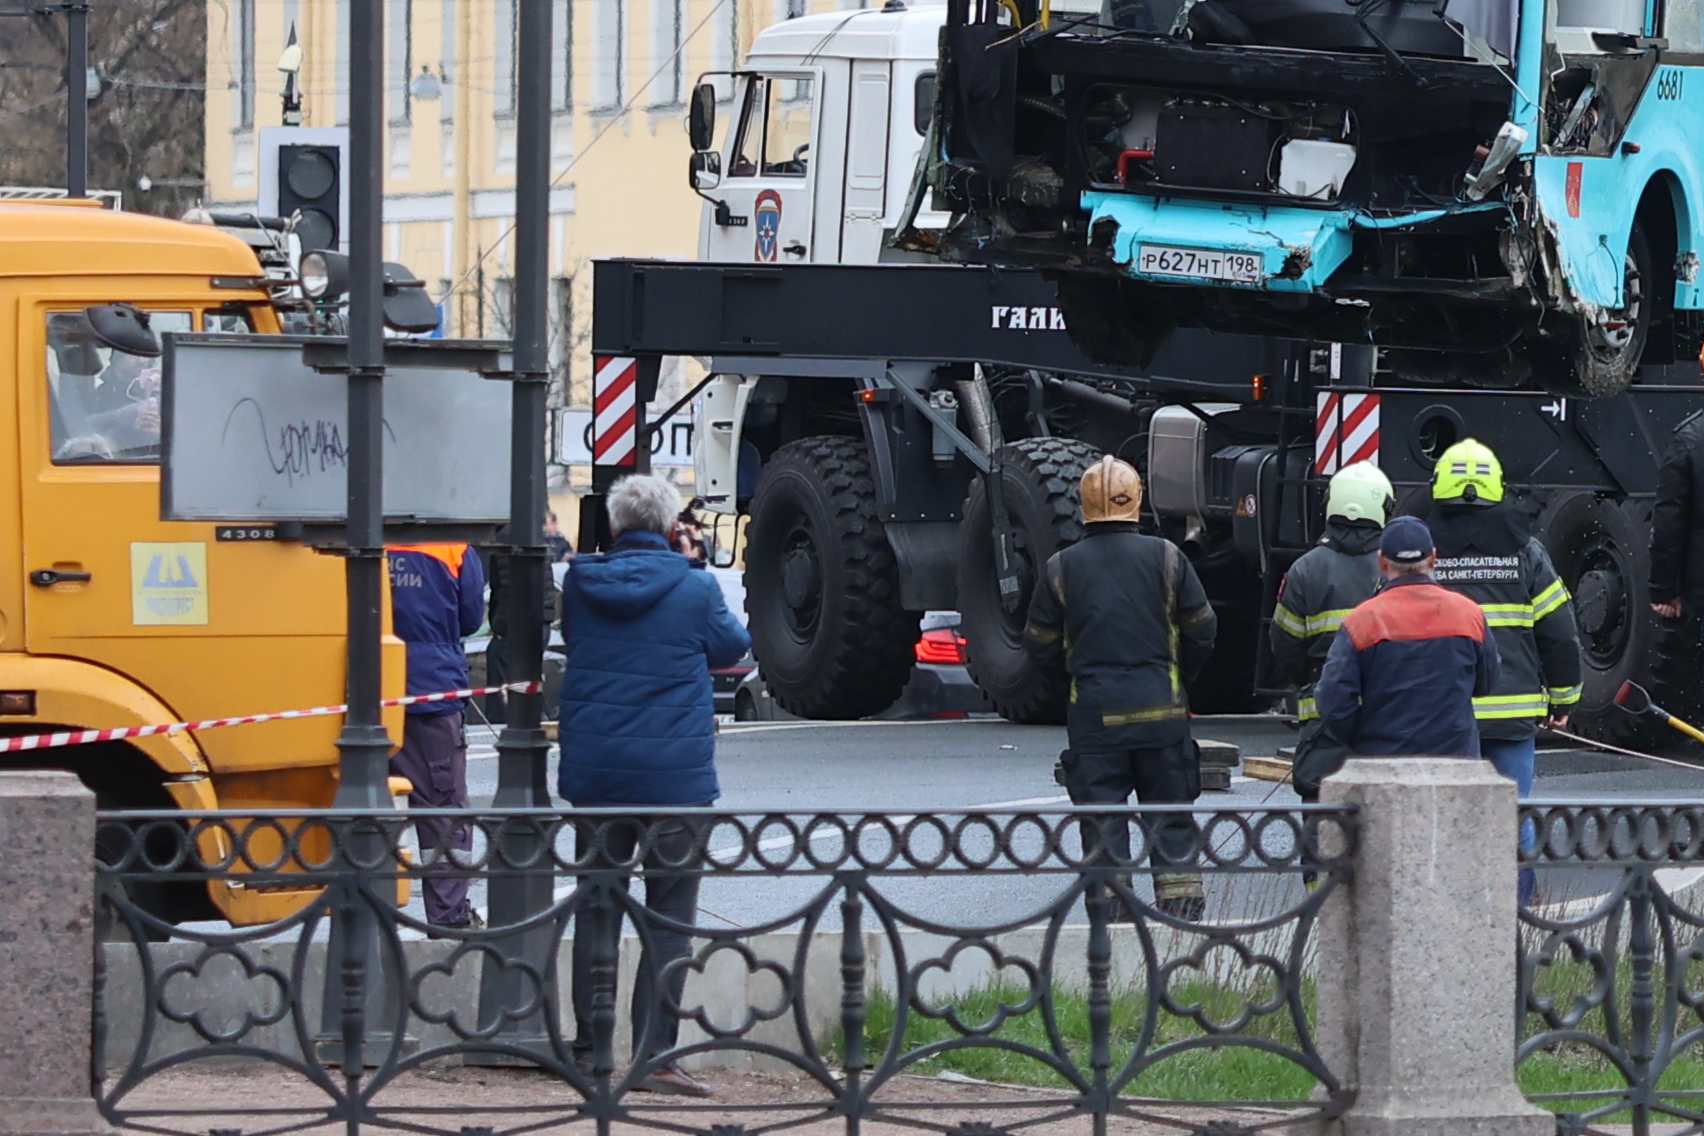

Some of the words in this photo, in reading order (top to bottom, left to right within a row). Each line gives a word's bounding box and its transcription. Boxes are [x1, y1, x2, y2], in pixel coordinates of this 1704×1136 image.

[1657, 70, 1683, 100] 6681
[1225, 256, 1254, 273] 198
[222, 529, 275, 539] 4308
[1448, 568, 1519, 580] САНКТ-ПЕТЕРБУРГА
